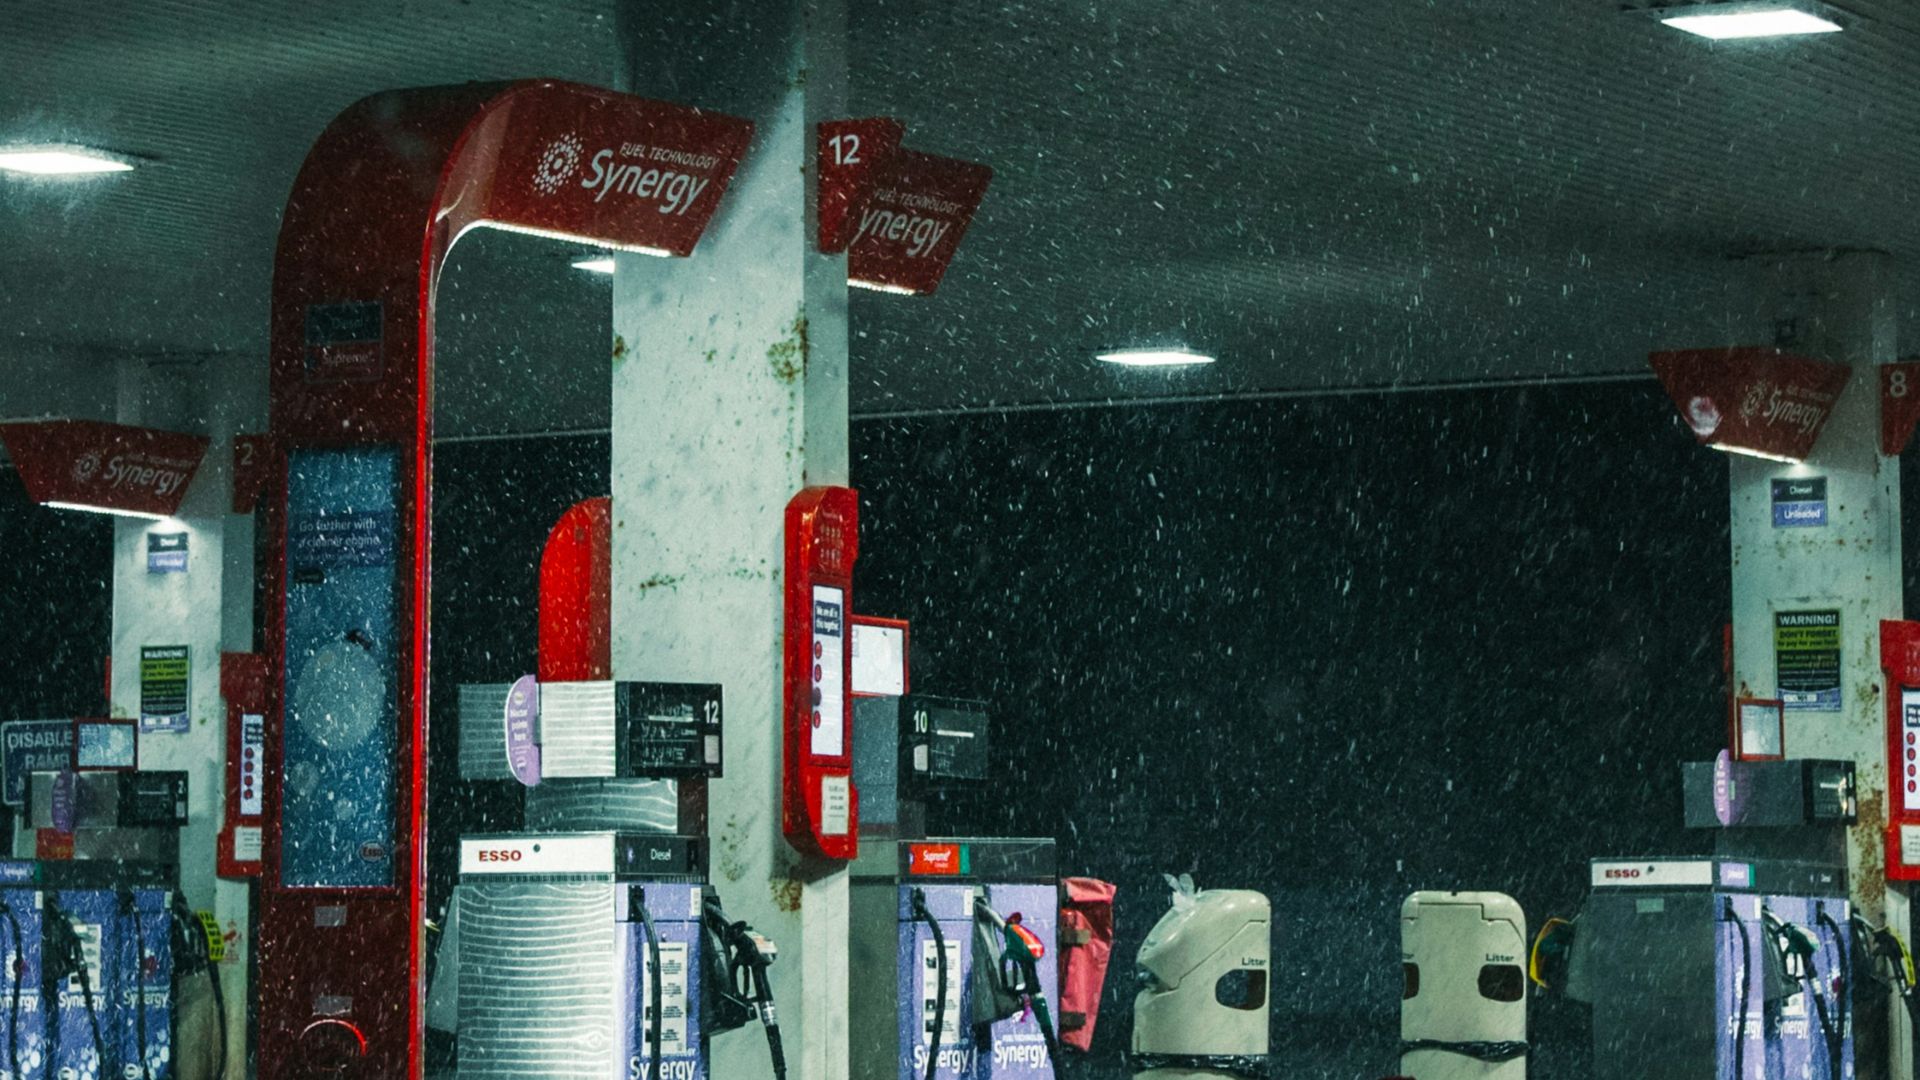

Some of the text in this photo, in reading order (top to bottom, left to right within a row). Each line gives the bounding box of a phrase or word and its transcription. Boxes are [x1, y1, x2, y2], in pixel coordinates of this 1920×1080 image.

[619, 142, 720, 170] FUEL TECHNOLOGY
[828, 134, 861, 166] 12
[581, 149, 709, 216] Synergy
[851, 208, 951, 258] ynergy
[1889, 371, 1907, 398] 8
[1762, 389, 1827, 435] Synergy
[102, 455, 187, 496] Synergy
[1779, 614, 1836, 625] WARNING!
[704, 699, 719, 724] 12
[913, 710, 928, 733] 10
[8, 732, 72, 748] DISABLE
[478, 850, 522, 862] ESSO
[1605, 869, 1640, 878] ESSO
[1241, 956, 1266, 966] Litter
[1485, 953, 1514, 962] Litter
[58, 991, 105, 1012] Synegy
[122, 990, 169, 1010] Syergy
[994, 1040, 1047, 1070] Synergy
[630, 1056, 697, 1080] Syergy
